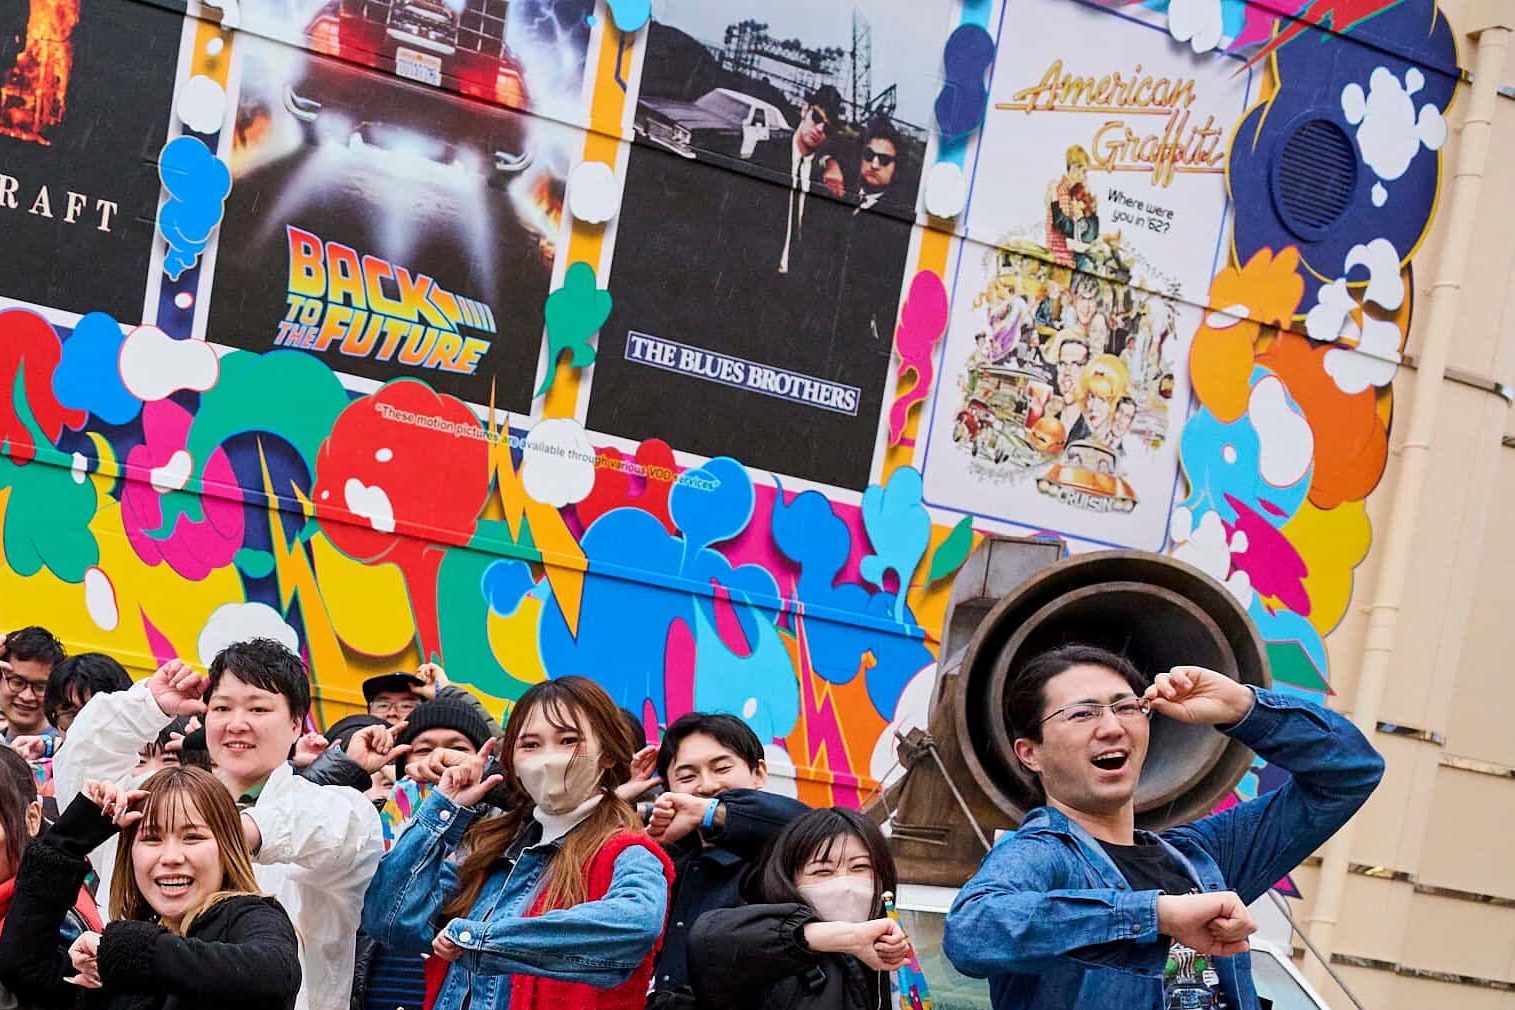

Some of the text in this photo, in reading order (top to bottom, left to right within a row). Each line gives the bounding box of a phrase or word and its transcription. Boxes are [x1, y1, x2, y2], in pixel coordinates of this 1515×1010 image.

[1013, 59, 1196, 114] American
[1092, 108, 1224, 188] Graffiti
[1108, 188, 1174, 219] Where were
[1111, 210, 1171, 234] you in '62?
[286, 224, 459, 333] BACK
[286, 294, 324, 326] TO
[273, 303, 491, 376] THE FUTURE
[631, 335, 857, 411] THE BLUES BROTHERS
[416, 415, 453, 431] motion
[456, 423, 498, 442] pictures
[502, 435, 519, 447] are
[520, 438, 565, 457] available
[568, 448, 607, 468] through
[610, 460, 646, 474] various
[649, 466, 671, 480] VOD
